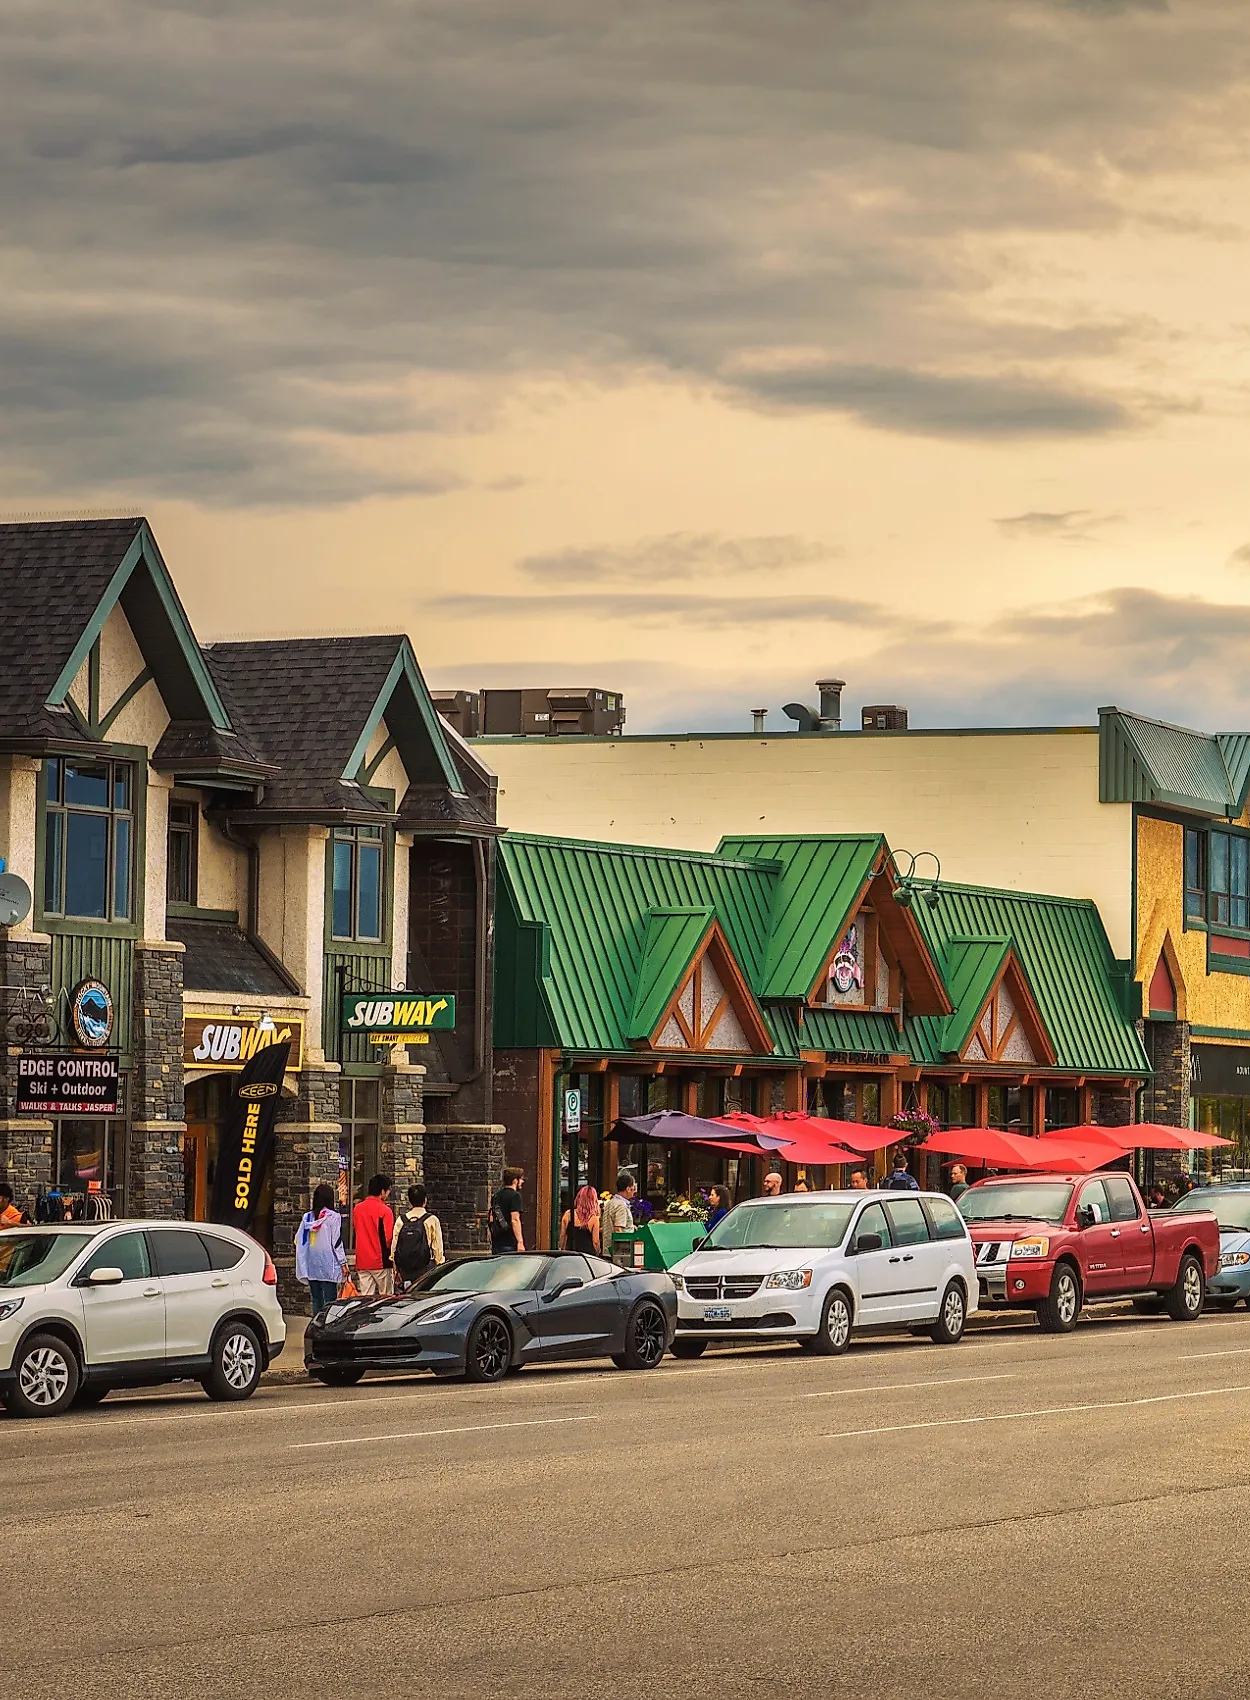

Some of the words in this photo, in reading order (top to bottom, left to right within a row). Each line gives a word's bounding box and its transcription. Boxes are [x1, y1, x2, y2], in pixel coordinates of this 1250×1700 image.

[347, 997, 448, 1028] SUBWAY
[16, 1023, 50, 1038] 626
[192, 1024, 292, 1062] SUBWAY
[19, 1060, 54, 1077] EDGE
[57, 1060, 118, 1078] CONTROL
[29, 1081, 48, 1095] Ski
[61, 1082, 107, 1096] Outdoor
[240, 1085, 276, 1097] KEEN
[20, 1101, 48, 1111] WALKS
[50, 1102, 57, 1111] &
[59, 1102, 82, 1112] TALKS
[84, 1103, 114, 1112] JASPER
[241, 1103, 261, 1154] HERE
[234, 1158, 253, 1210] SOLD
